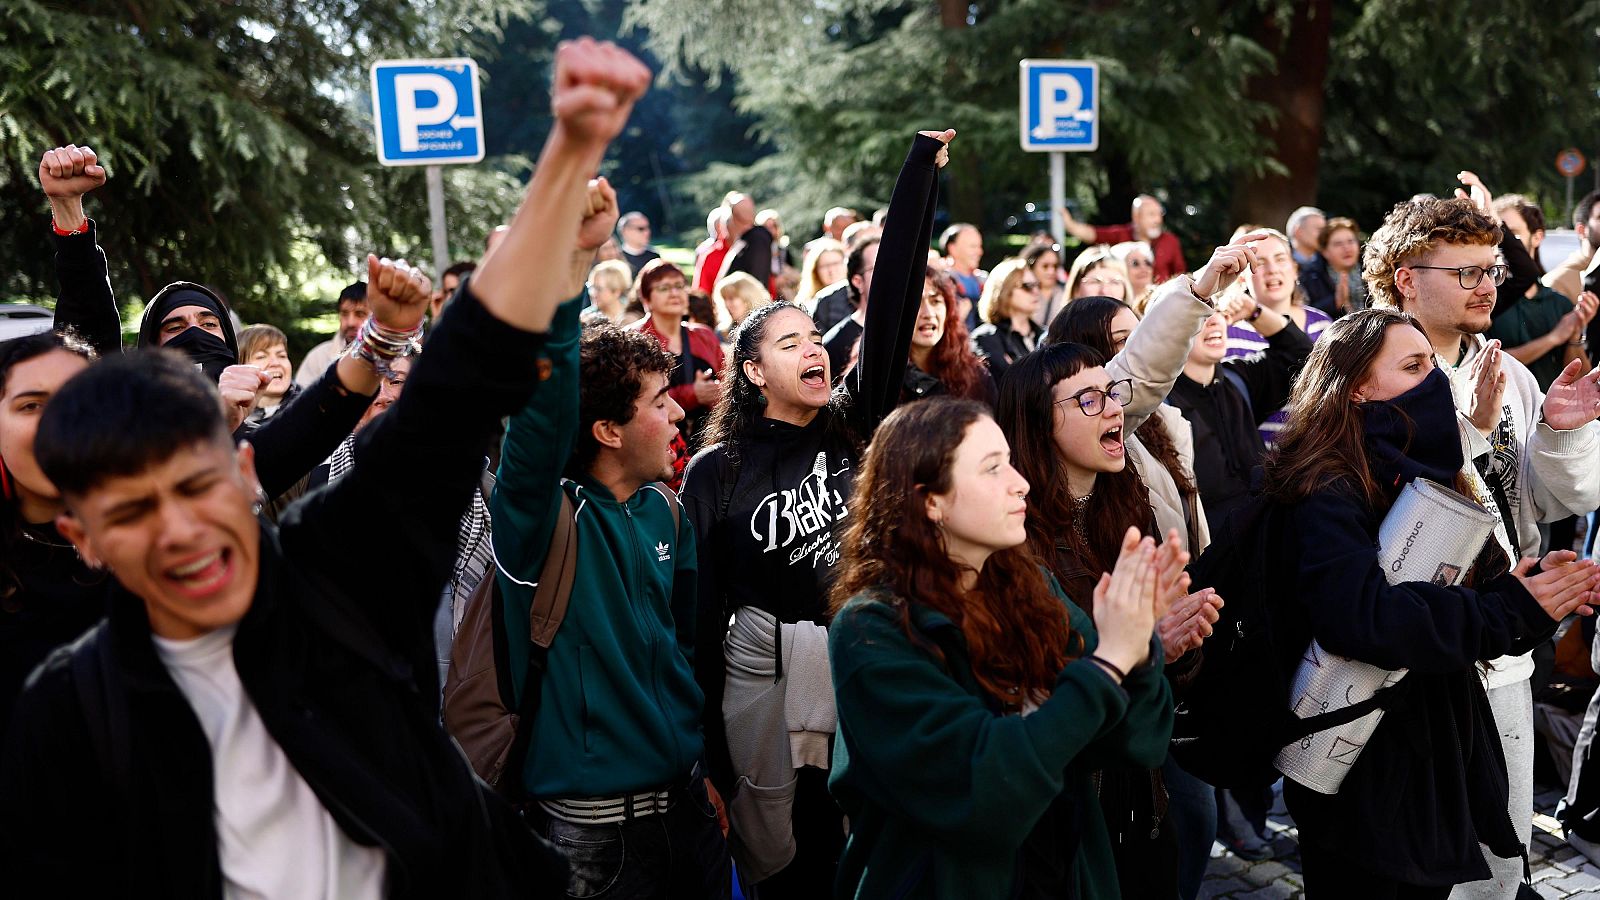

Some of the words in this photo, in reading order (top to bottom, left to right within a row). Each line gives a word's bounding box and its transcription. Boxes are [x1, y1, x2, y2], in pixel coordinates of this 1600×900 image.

[394, 73, 458, 153] P
[1039, 72, 1083, 138] P
[789, 531, 831, 566] Lucha
[1391, 520, 1424, 573] Quechua
